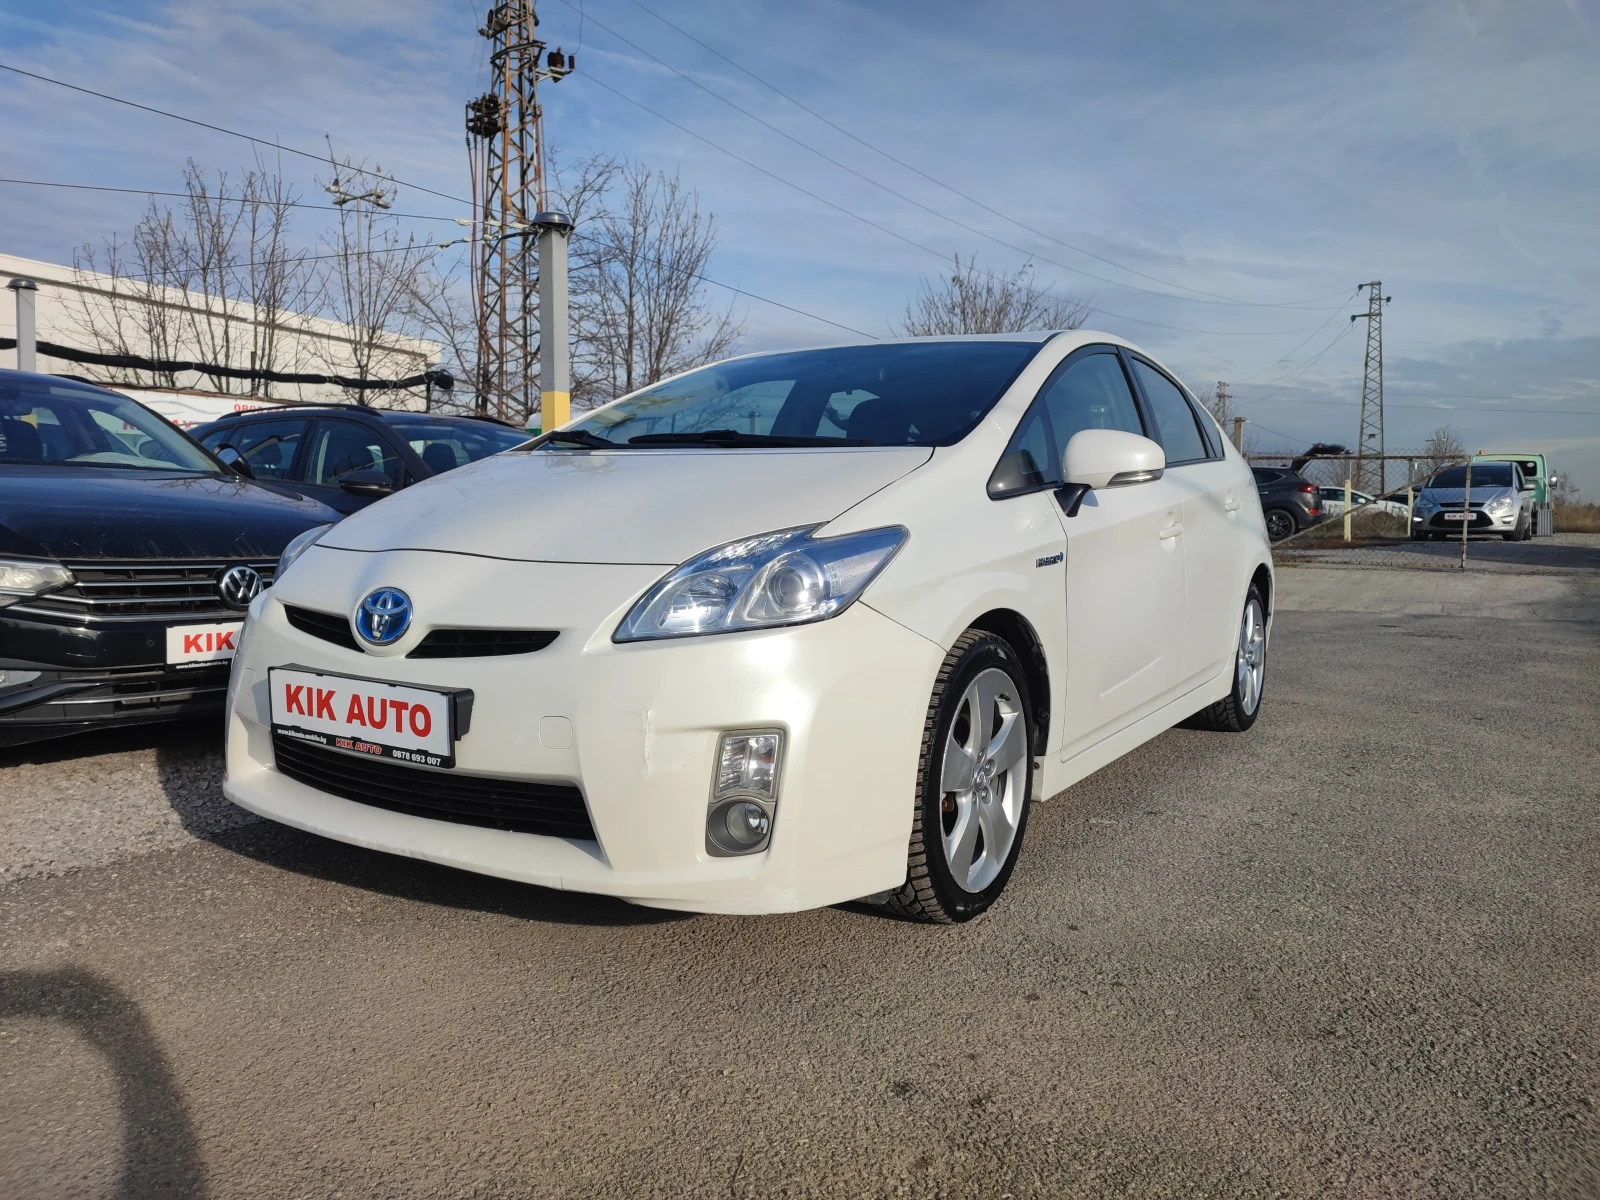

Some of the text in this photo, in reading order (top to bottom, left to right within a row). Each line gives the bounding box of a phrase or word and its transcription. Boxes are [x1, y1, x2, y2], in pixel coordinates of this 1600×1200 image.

[184, 631, 235, 654] KIK
[285, 683, 432, 738] KIK AUTO
[335, 737, 383, 755] KIK AUTO
[392, 749, 441, 766] 0878 693 007
